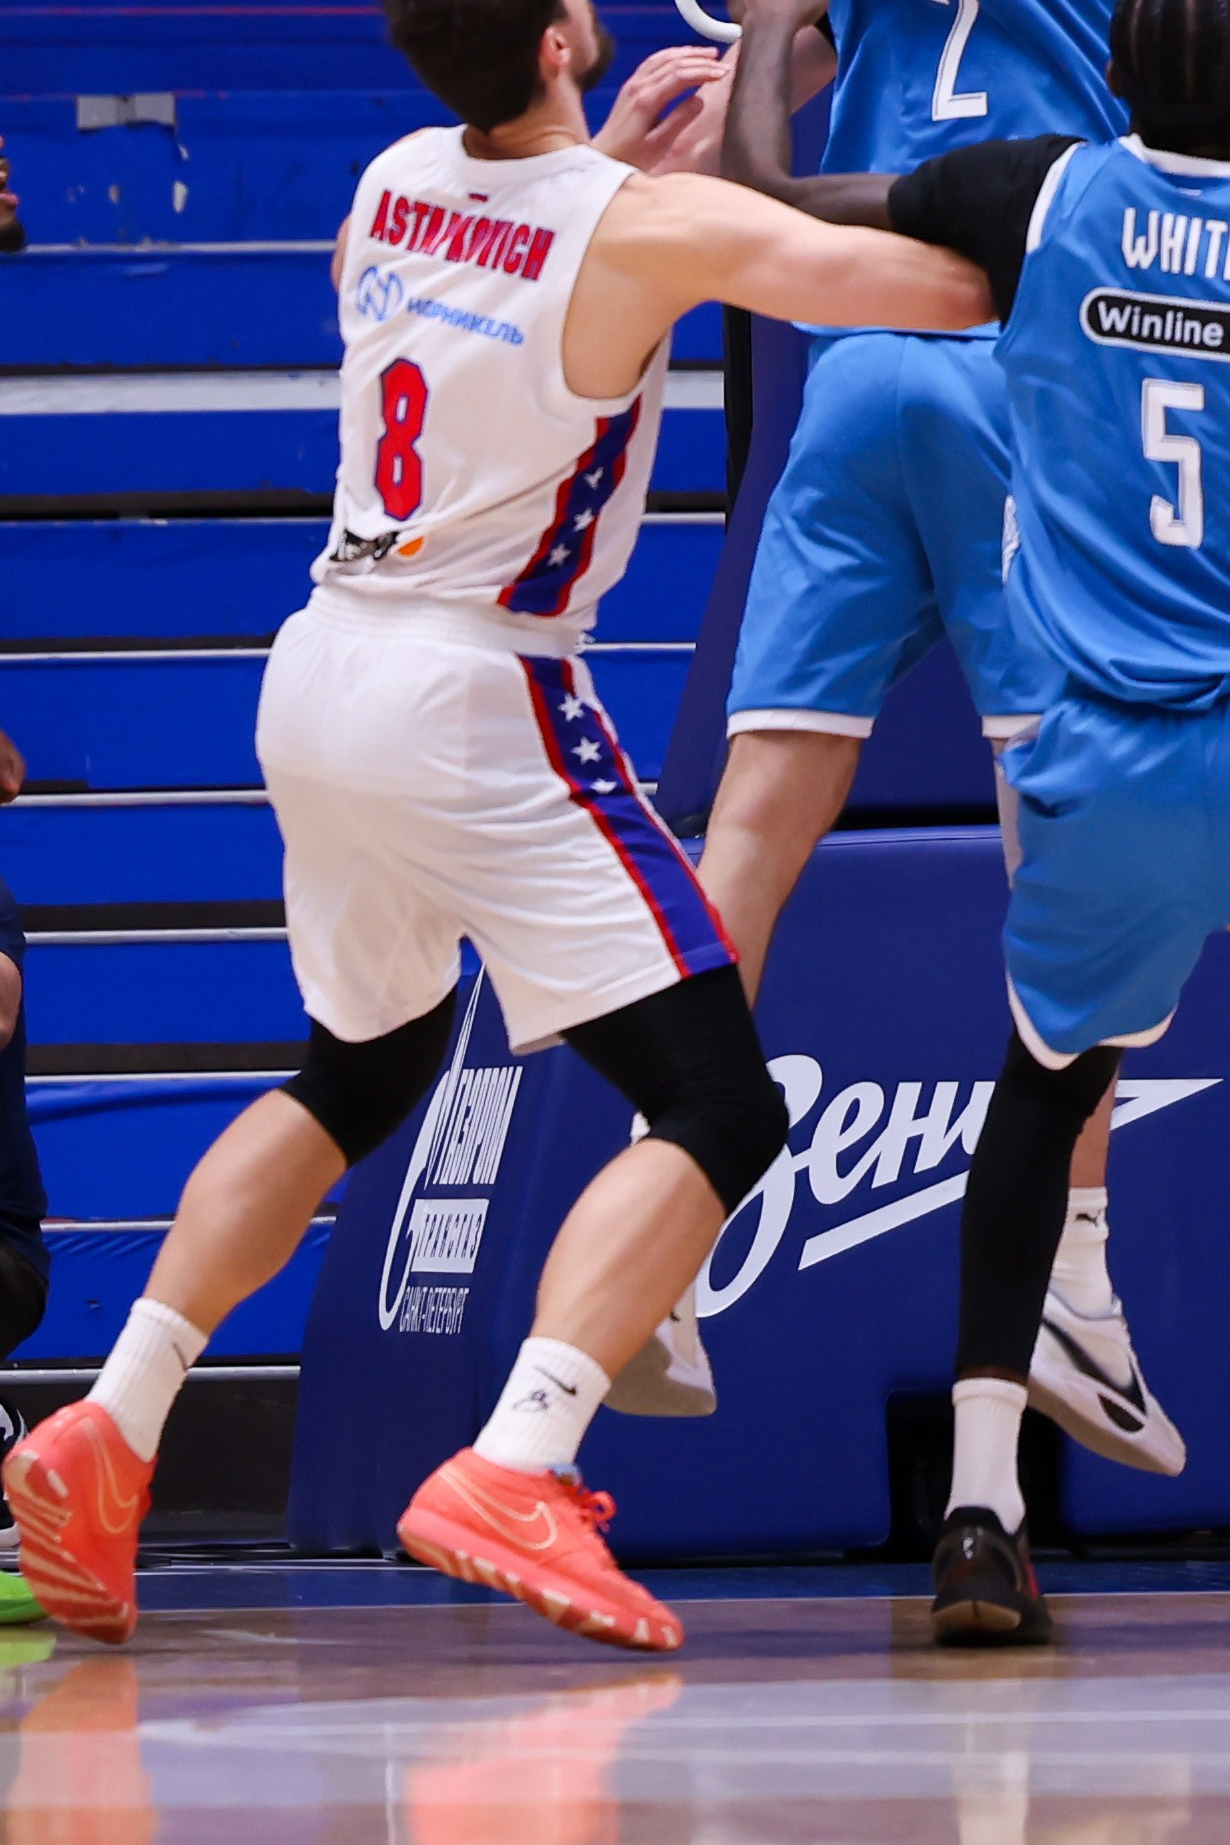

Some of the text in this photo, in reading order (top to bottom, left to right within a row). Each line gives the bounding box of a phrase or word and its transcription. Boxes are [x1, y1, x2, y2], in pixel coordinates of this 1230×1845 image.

[1098, 299, 1225, 348] Winline
[374, 356, 428, 522] 8
[1141, 377, 1205, 551] 5
[432, 1065, 524, 1186] ГАЗПРОМ
